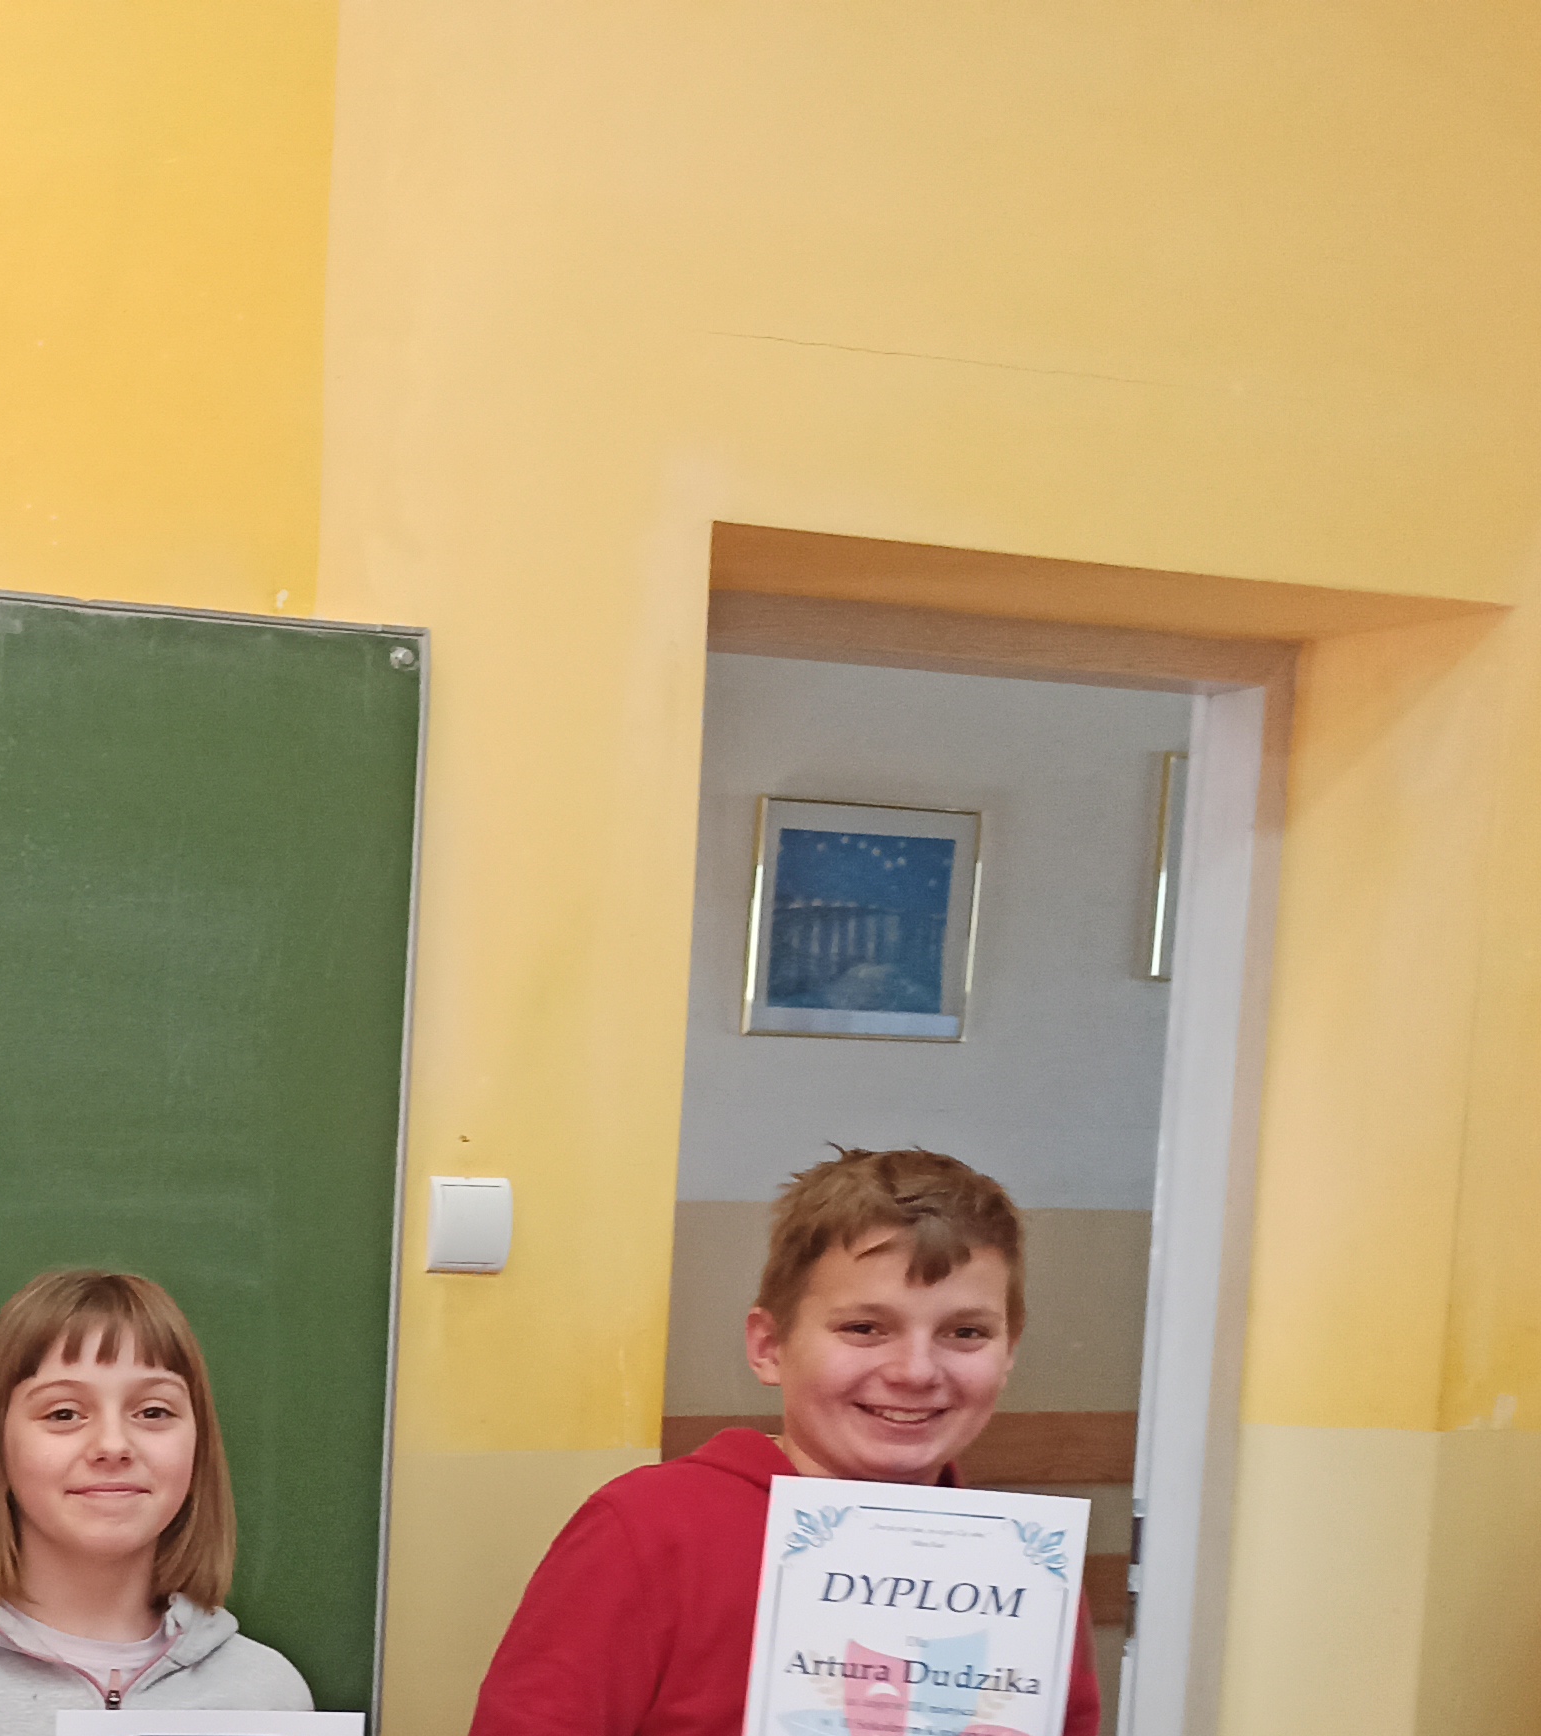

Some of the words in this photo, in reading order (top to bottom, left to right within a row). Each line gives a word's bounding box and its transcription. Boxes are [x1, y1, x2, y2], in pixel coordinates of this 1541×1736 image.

[819, 1571, 1027, 1618] DYPLOM
[785, 1650, 890, 1682] Artura
[903, 1659, 1041, 1695] Dudzika
